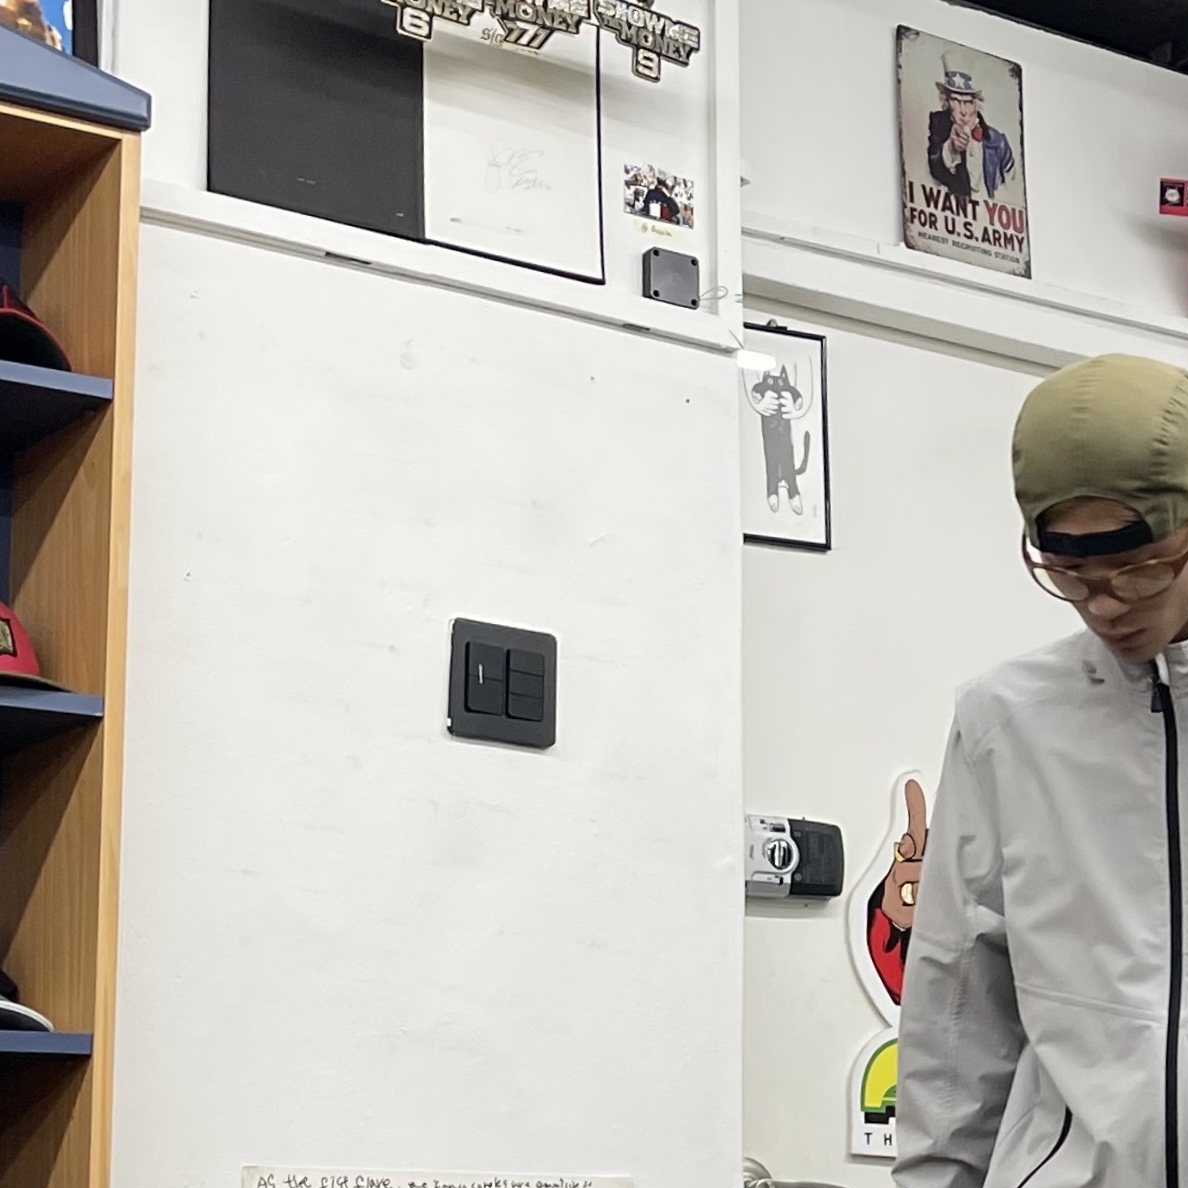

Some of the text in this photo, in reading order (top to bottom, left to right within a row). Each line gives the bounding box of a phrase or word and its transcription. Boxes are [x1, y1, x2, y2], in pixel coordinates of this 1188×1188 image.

[402, 7, 431, 38] 6
[637, 48, 660, 78] 9
[908, 181, 1025, 234] I WANT YOU
[909, 207, 939, 231] FOR
